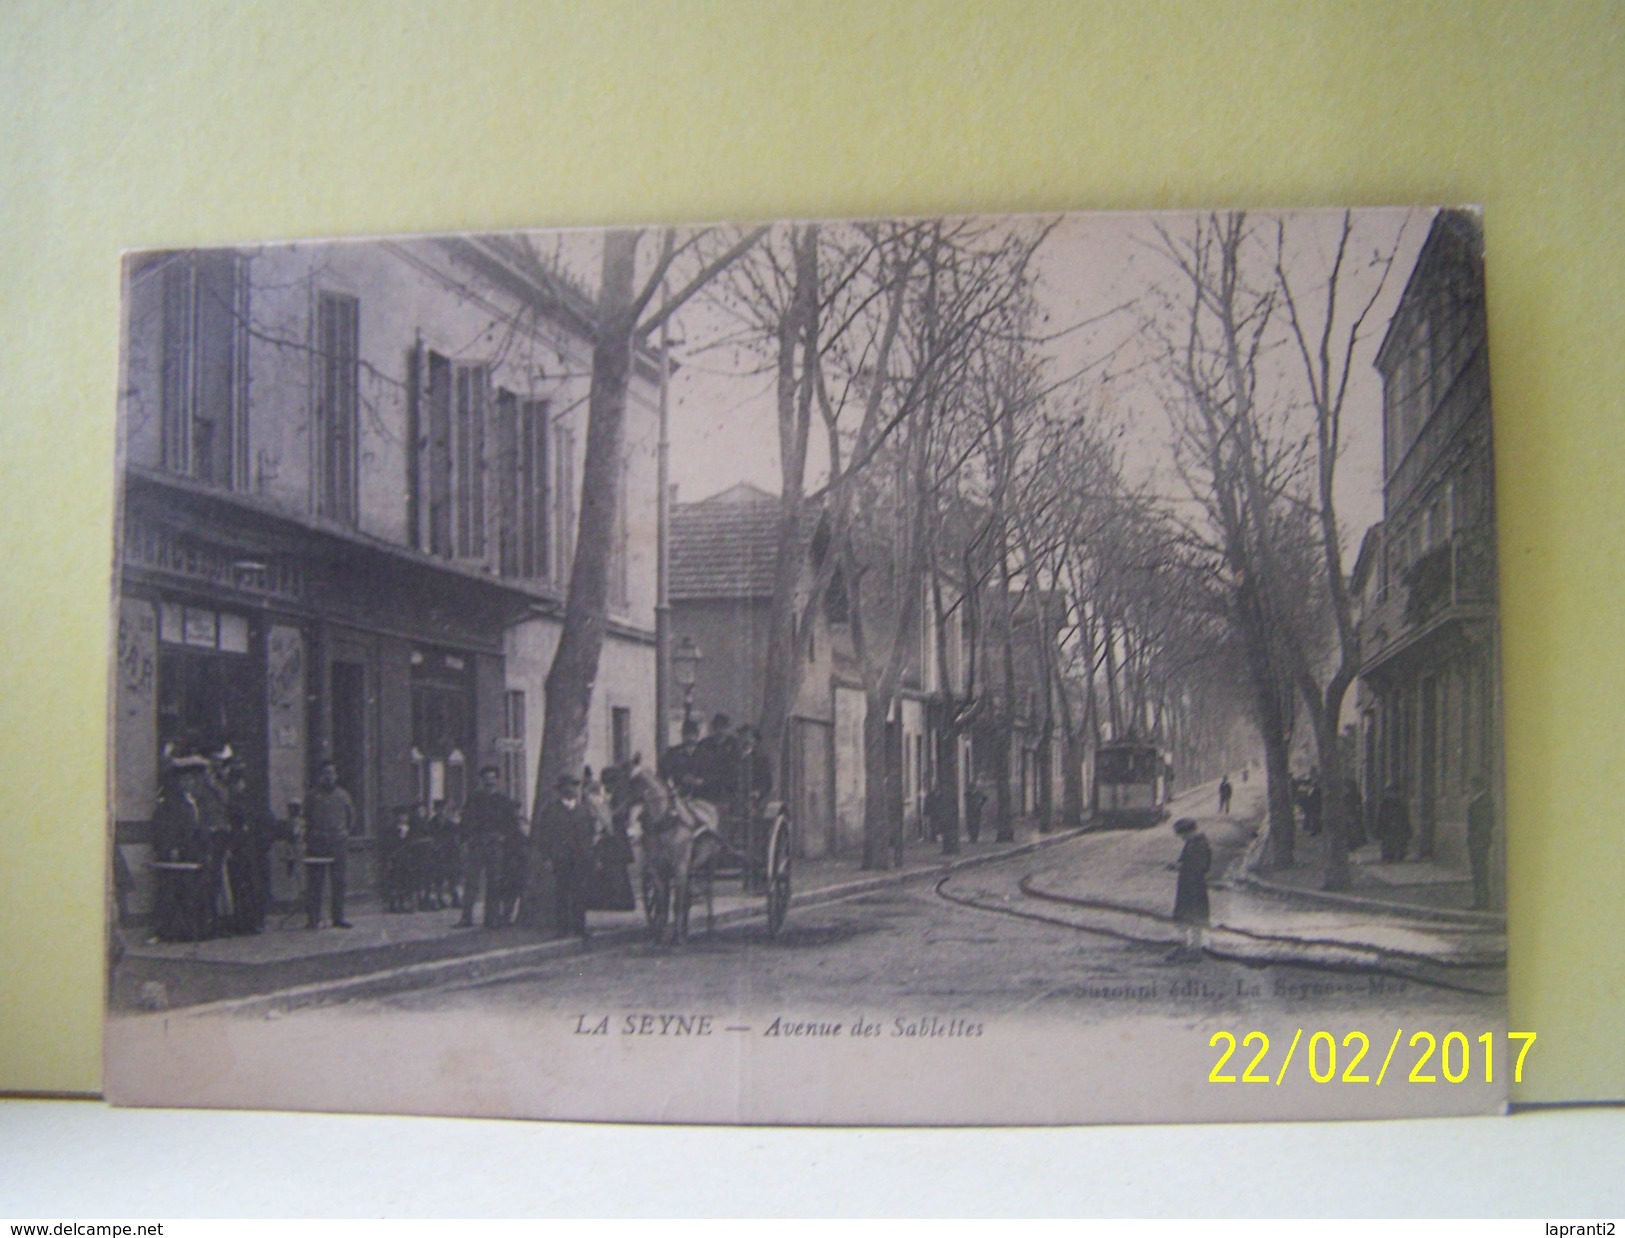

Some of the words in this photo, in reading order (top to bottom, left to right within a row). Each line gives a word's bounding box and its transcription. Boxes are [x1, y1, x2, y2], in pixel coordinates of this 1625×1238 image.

[573, 1014, 609, 1035] LA
[621, 1014, 714, 1036] SEYNE
[763, 1015, 842, 1038] Avenue
[850, 1016, 881, 1038] des
